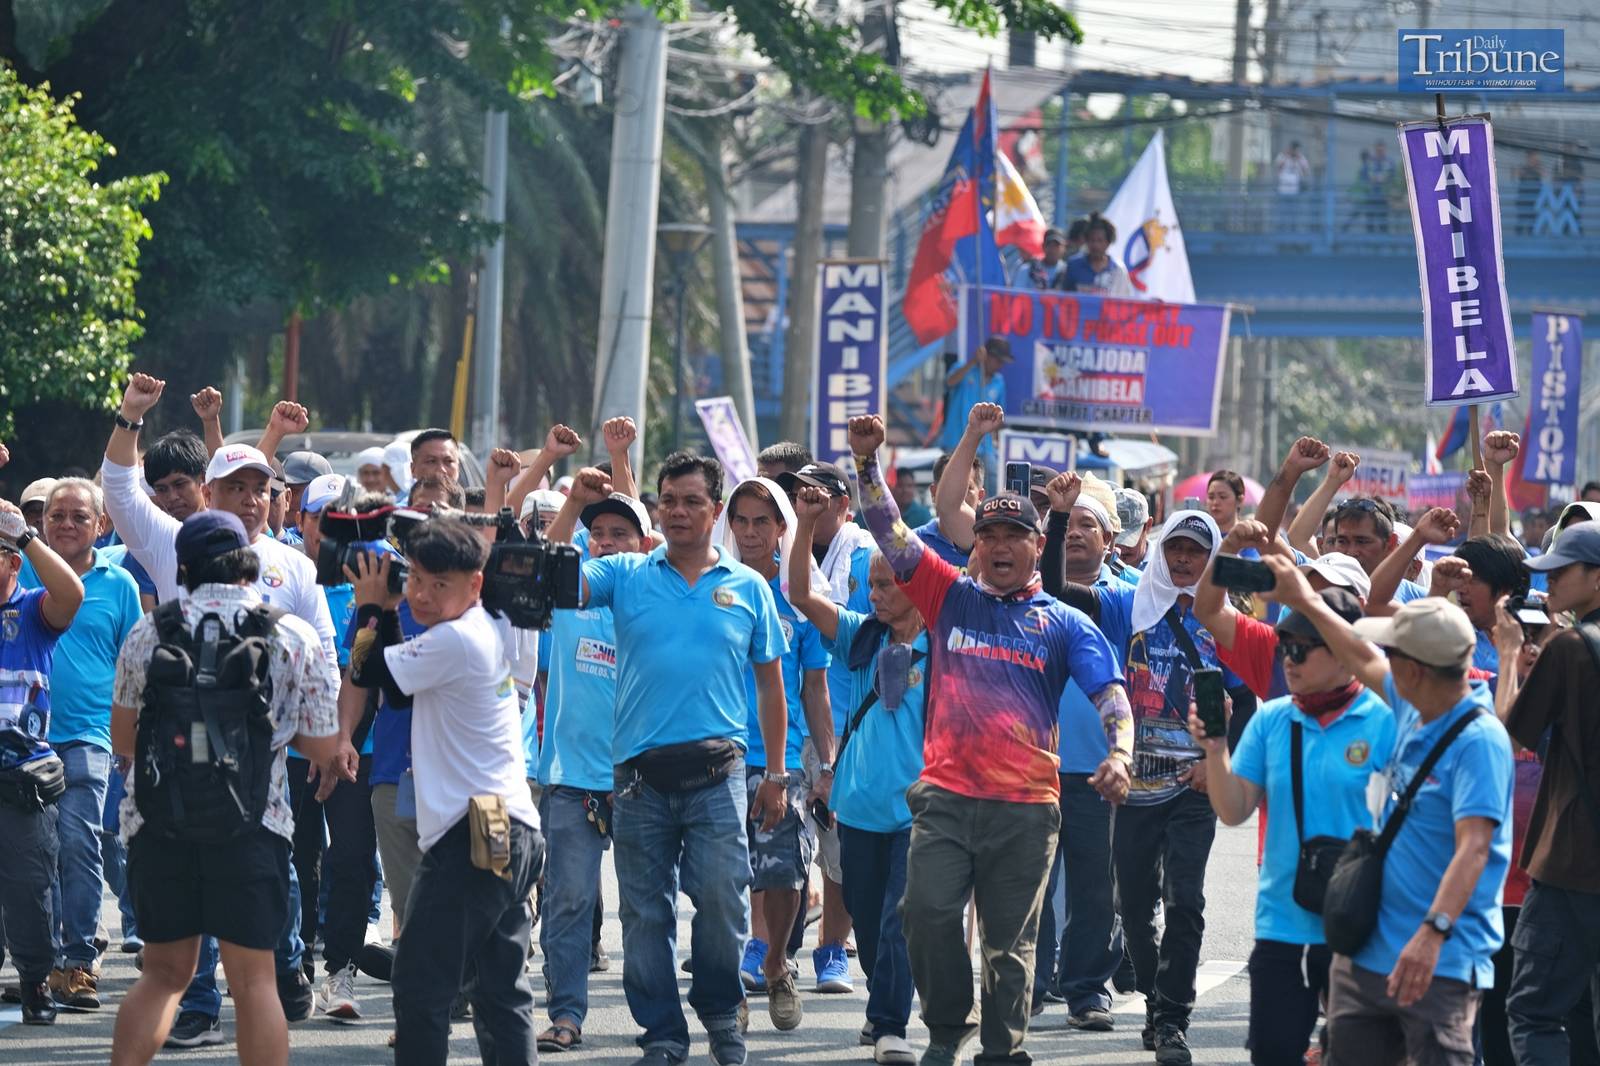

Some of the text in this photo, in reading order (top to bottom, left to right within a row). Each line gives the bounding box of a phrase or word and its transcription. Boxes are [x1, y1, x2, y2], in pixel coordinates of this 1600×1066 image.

[1423, 129, 1494, 396] MANIBELA
[991, 292, 1079, 340] NO TO
[1152, 323, 1195, 348] OUT
[1535, 315, 1570, 480] PISTON
[984, 499, 1021, 511] GUCCI
